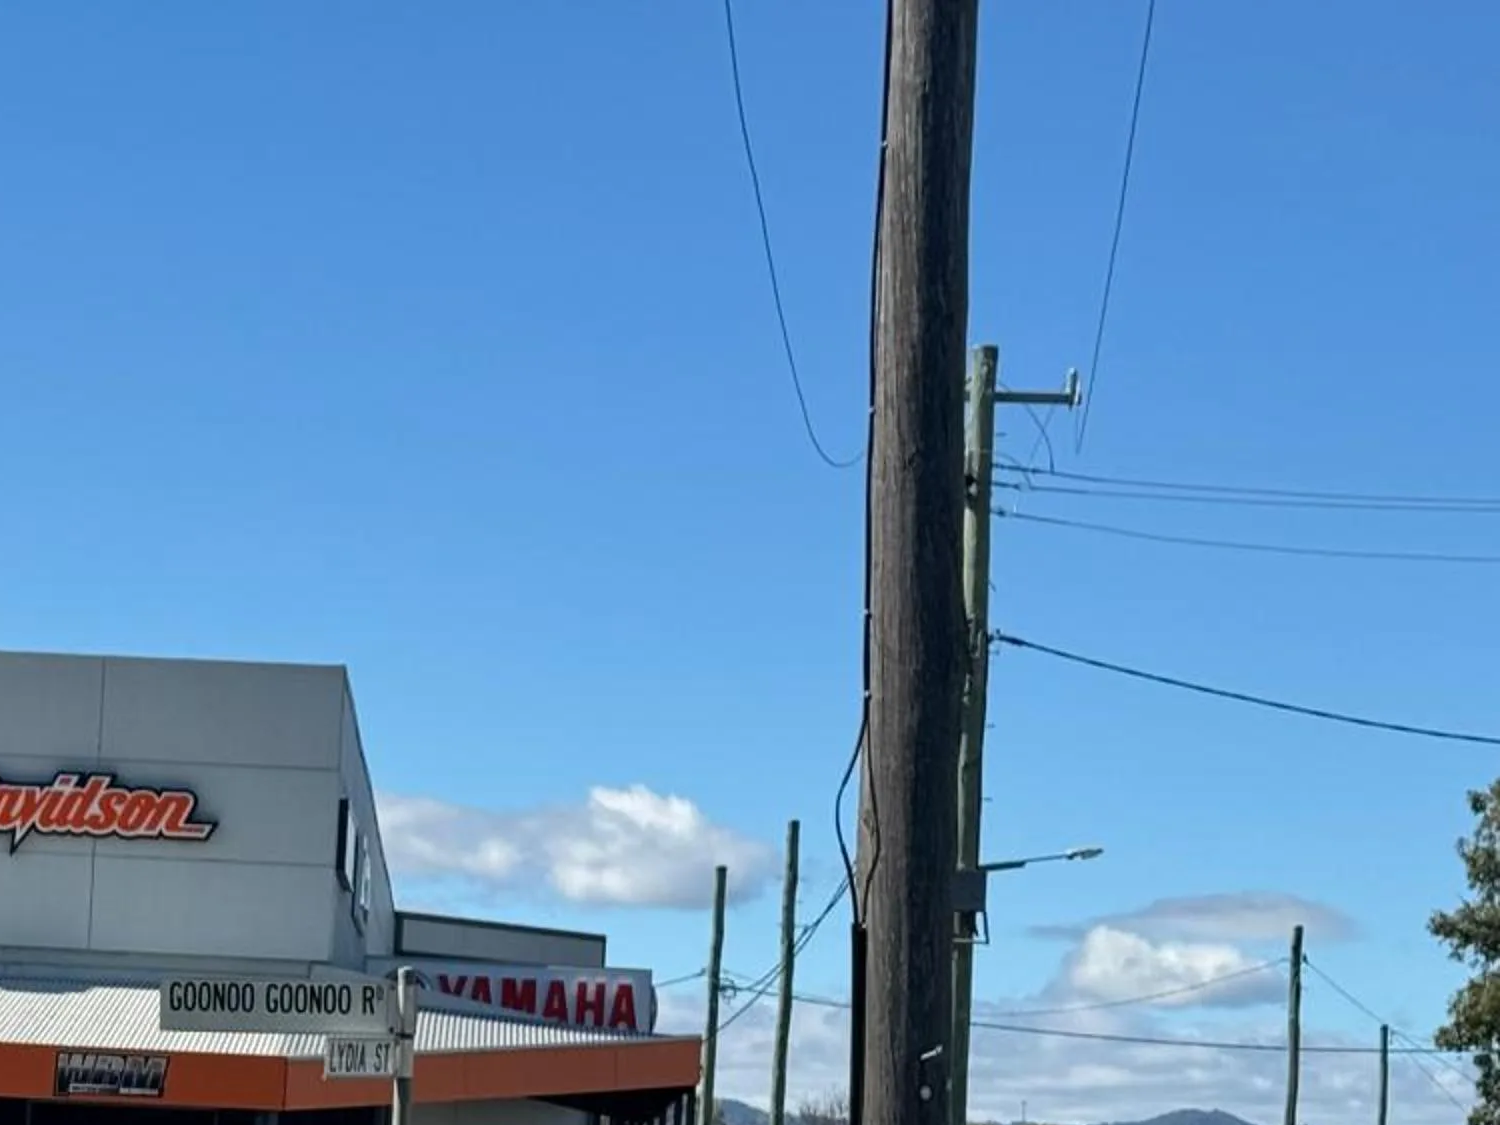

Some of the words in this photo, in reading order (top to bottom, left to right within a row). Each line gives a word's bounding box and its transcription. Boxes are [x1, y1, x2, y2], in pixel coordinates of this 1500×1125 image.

[169, 981, 255, 1013] GOONOO
[265, 983, 351, 1015] GOONOO
[436, 973, 637, 1030] YAMAHA
[328, 1042, 366, 1073] LYDIA
[372, 1043, 391, 1073] ST
